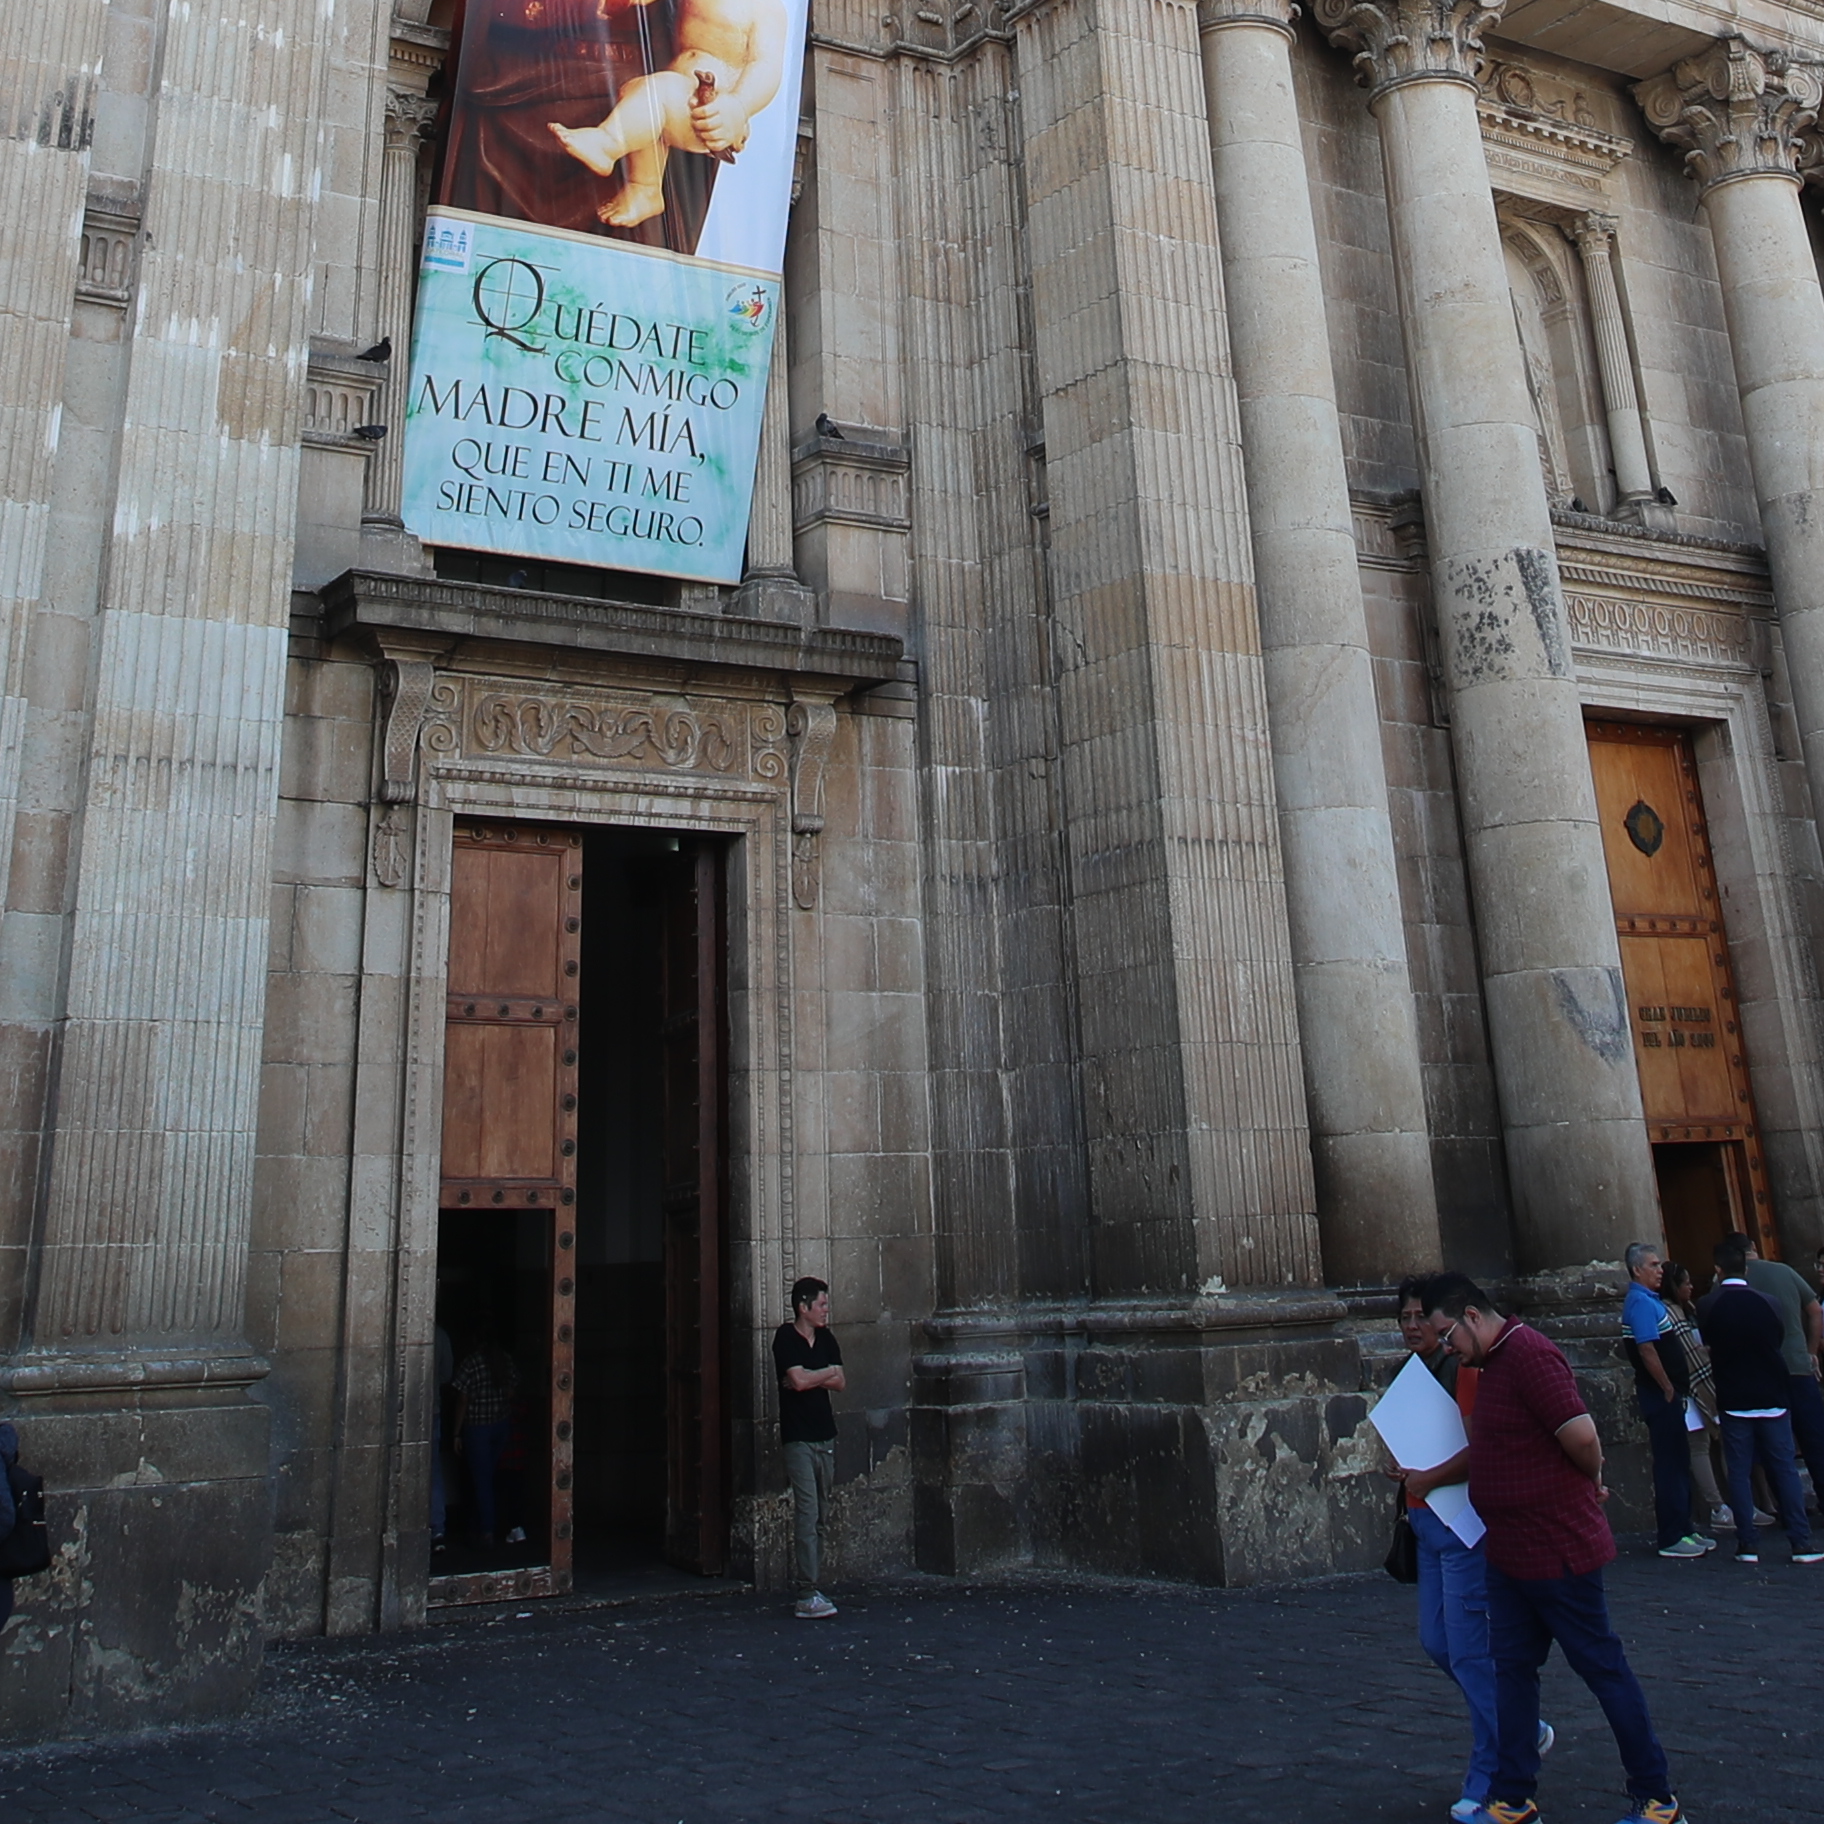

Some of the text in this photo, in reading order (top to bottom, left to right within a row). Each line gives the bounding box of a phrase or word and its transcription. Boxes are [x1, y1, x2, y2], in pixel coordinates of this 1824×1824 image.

[472, 257, 709, 366] QUÉDATE
[553, 349, 740, 411] CONMIGO
[416, 374, 707, 467] MADRE MÍA,
[451, 438, 693, 504] QUE EN TI ME
[436, 479, 704, 547] SIENTO SEGURO.
